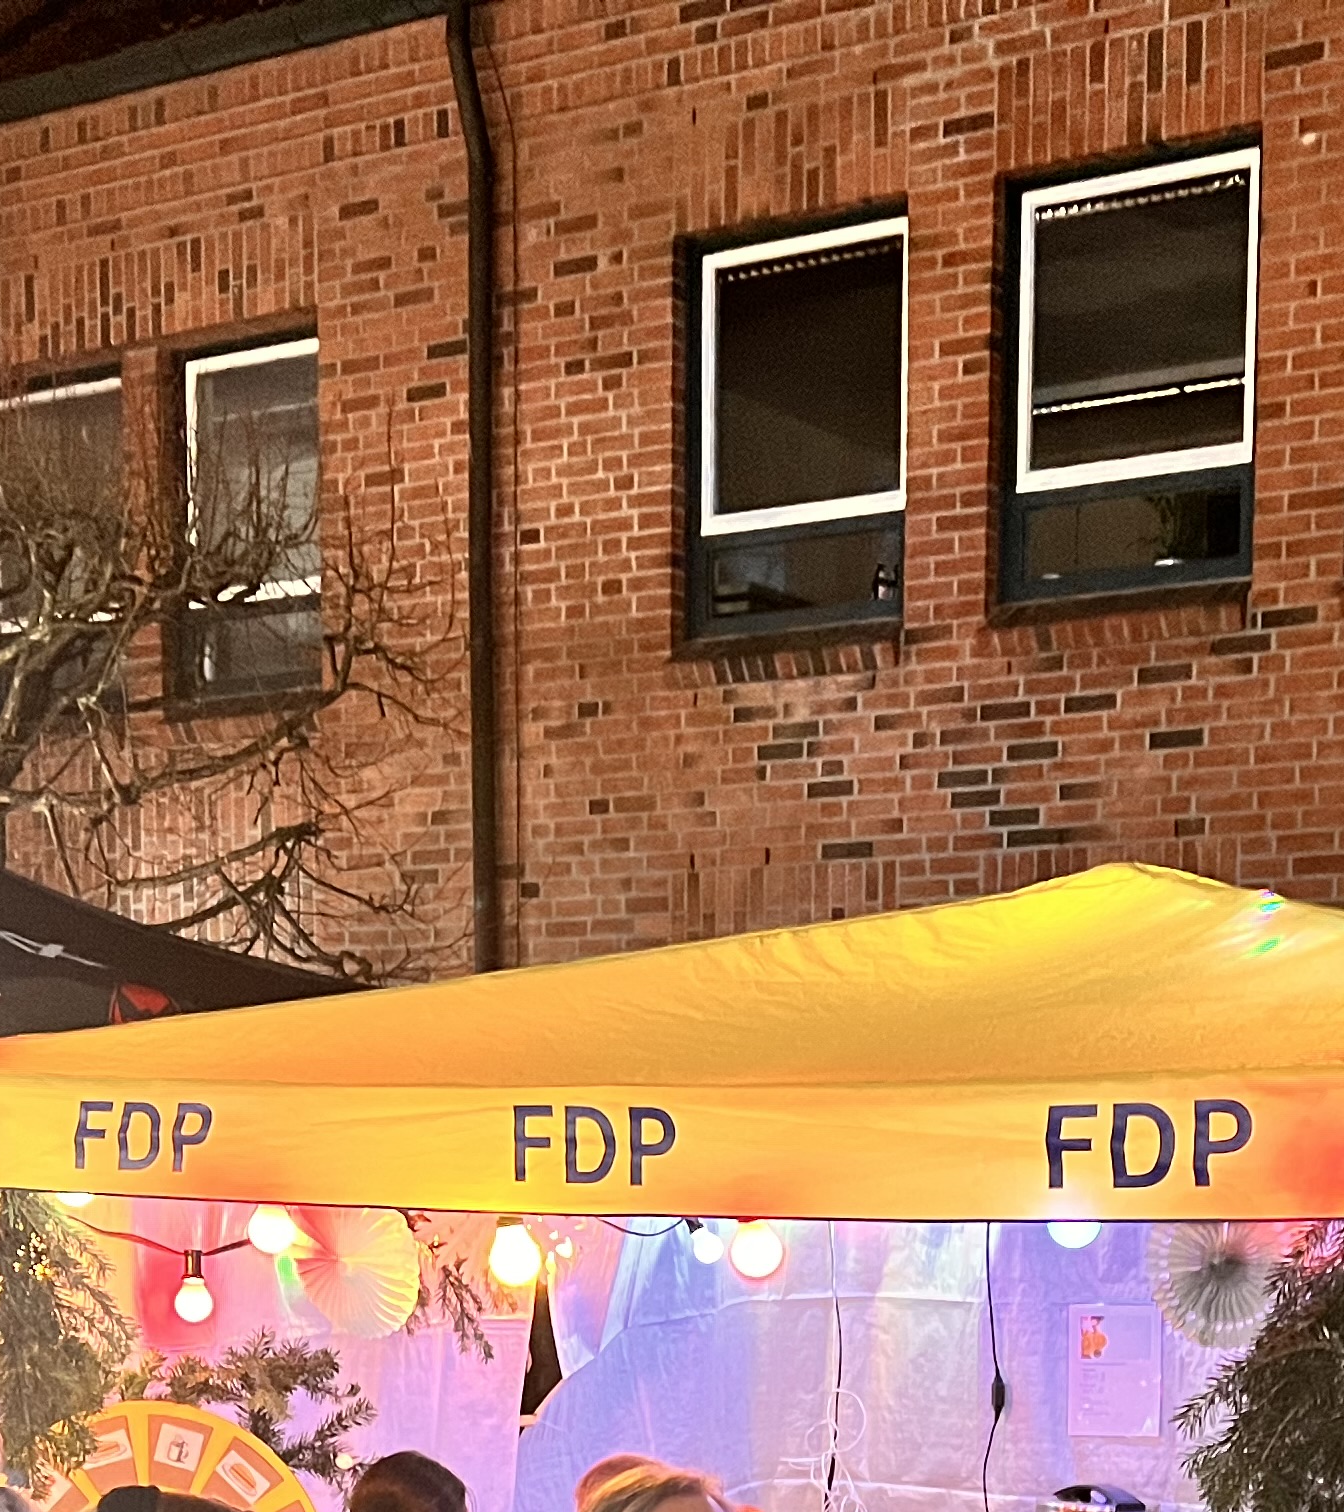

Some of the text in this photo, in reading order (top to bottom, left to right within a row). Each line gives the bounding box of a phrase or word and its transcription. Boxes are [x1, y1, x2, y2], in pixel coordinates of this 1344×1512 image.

[74, 1101, 212, 1172] FDP
[513, 1105, 676, 1186] FDP
[1046, 1099, 1253, 1188] FDP
